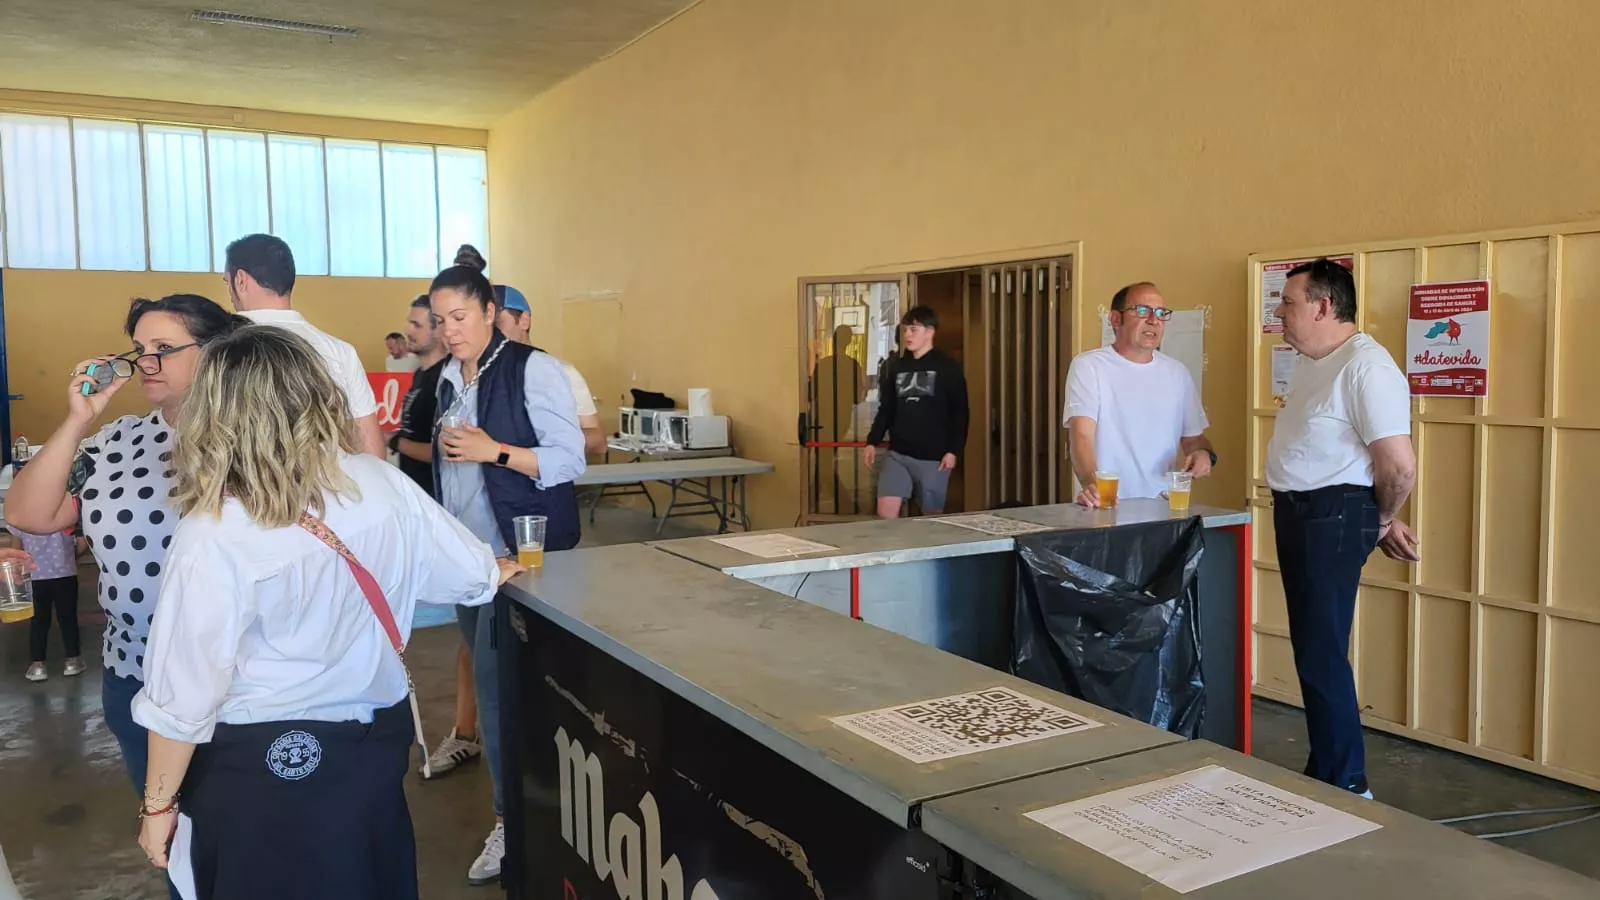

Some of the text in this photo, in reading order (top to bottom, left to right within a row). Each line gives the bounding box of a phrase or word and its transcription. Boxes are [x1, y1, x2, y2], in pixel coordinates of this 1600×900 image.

[1414, 349, 1482, 365] #datevida
[1225, 787, 1277, 808] DATEVIDA
[1234, 784, 1264, 796] LISTA
[1267, 796, 1315, 815] PRECIOS
